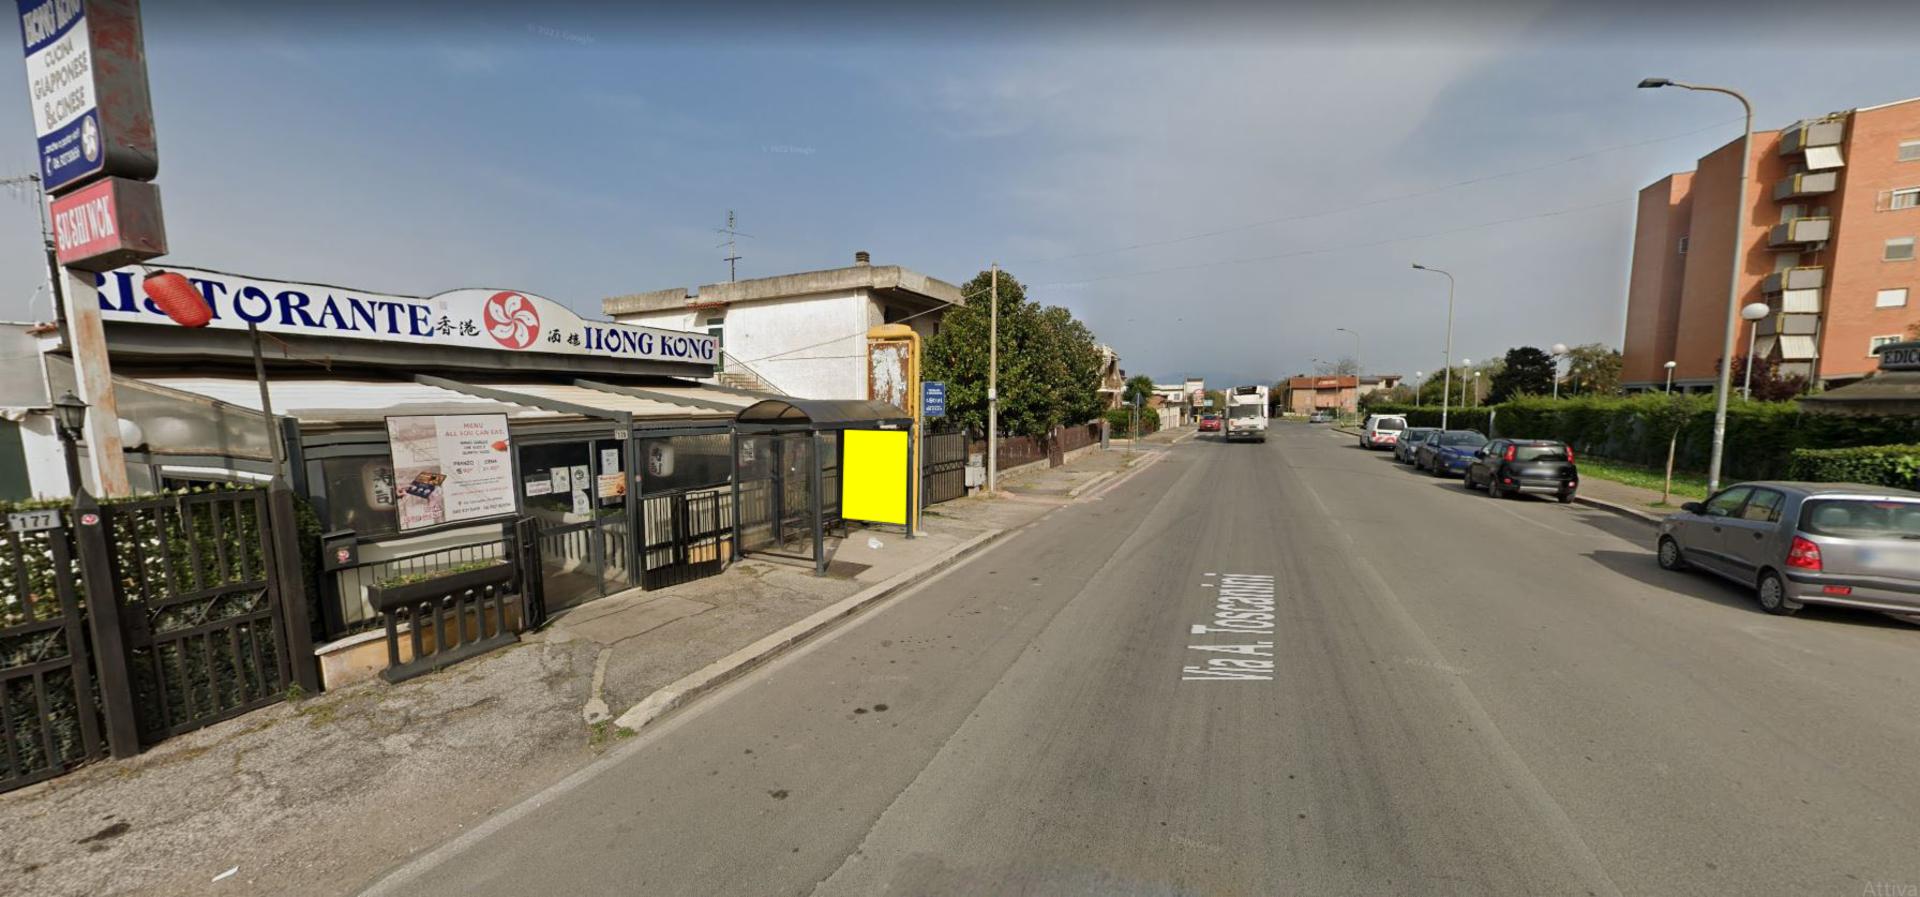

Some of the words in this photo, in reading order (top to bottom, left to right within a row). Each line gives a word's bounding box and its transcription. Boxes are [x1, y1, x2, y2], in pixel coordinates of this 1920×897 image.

[34, 51, 88, 100] GIAPPONESE
[56, 204, 91, 251] SUSHI
[86, 195, 114, 240] WOK
[94, 270, 435, 337] ITORANTE
[435, 315, 480, 337] 香港
[583, 326, 653, 355] HONG
[660, 335, 713, 360] KONG
[1884, 349, 1920, 364] EDIC
[20, 514, 50, 529] 177
